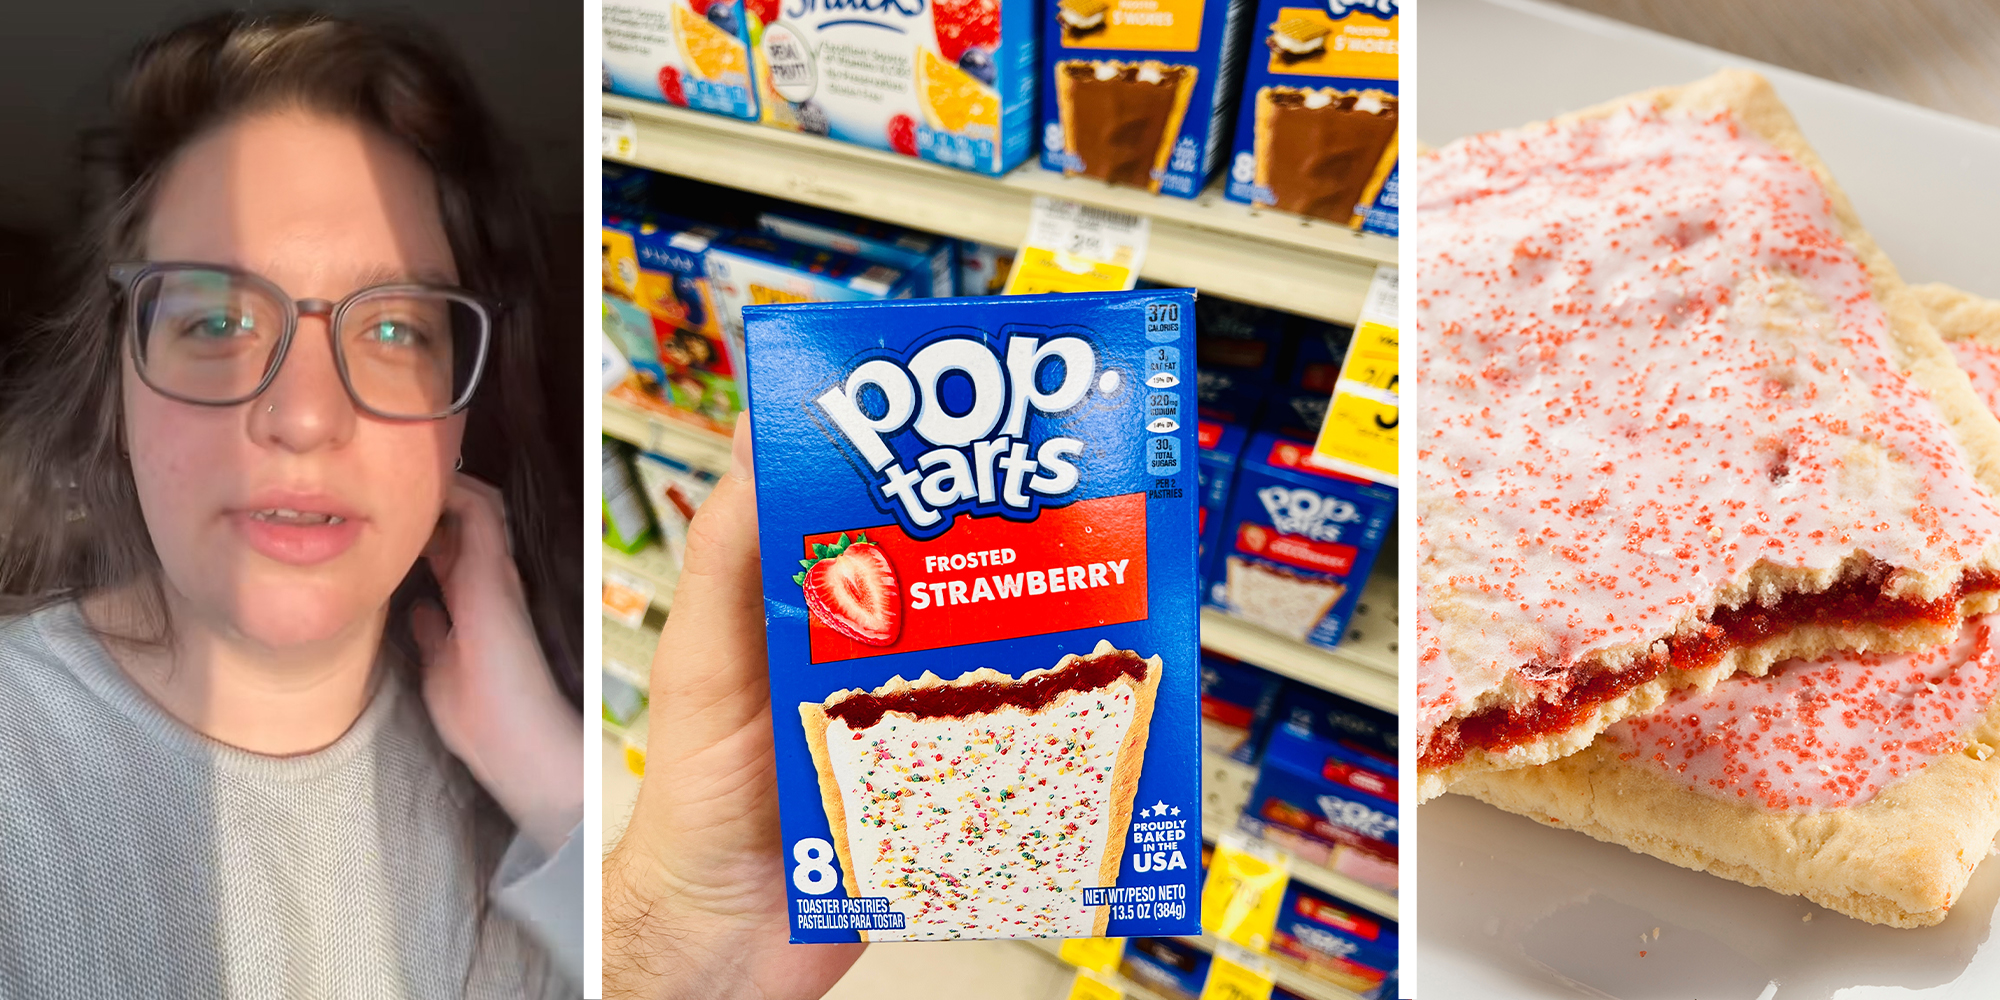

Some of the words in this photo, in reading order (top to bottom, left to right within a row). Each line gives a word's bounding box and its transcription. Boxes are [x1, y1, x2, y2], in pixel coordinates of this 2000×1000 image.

[1232, 152, 1255, 183] 8
[1148, 303, 1178, 322] 370
[1147, 323, 1179, 332] CALORIES
[1150, 362, 1163, 370] SAT
[1164, 362, 1176, 370] FAT
[1150, 407, 1176, 415] SODIUM
[1151, 459, 1177, 467] SUGARS
[1155, 451, 1173, 459] TOTAL
[882, 437, 1085, 527] tarts
[1155, 479, 1170, 488] PER
[1171, 478, 1176, 488] 2
[1149, 488, 1183, 499] PASTRIES
[925, 548, 1017, 573] FROSTED
[910, 559, 1130, 610] STRAWBERRY
[1133, 819, 1187, 832] PROUDLY
[1133, 829, 1186, 843] BAKED
[1143, 844, 1155, 852] IN
[1158, 842, 1178, 851] THE
[793, 837, 838, 895] 8
[1133, 851, 1187, 873] USA
[1084, 888, 1105, 905] NET
[1108, 886, 1156, 904] WT/PESO
[1158, 883, 1186, 901] NETO
[796, 899, 840, 913] TOASTER
[842, 898, 889, 914] PASTRIES
[1112, 904, 1135, 920] 13.5
[1137, 903, 1151, 919] OZ
[1153, 900, 1186, 921] (384g)
[798, 914, 849, 929] PASTELILLOS
[850, 914, 872, 929] PARA
[873, 913, 904, 928] TOSTAR
